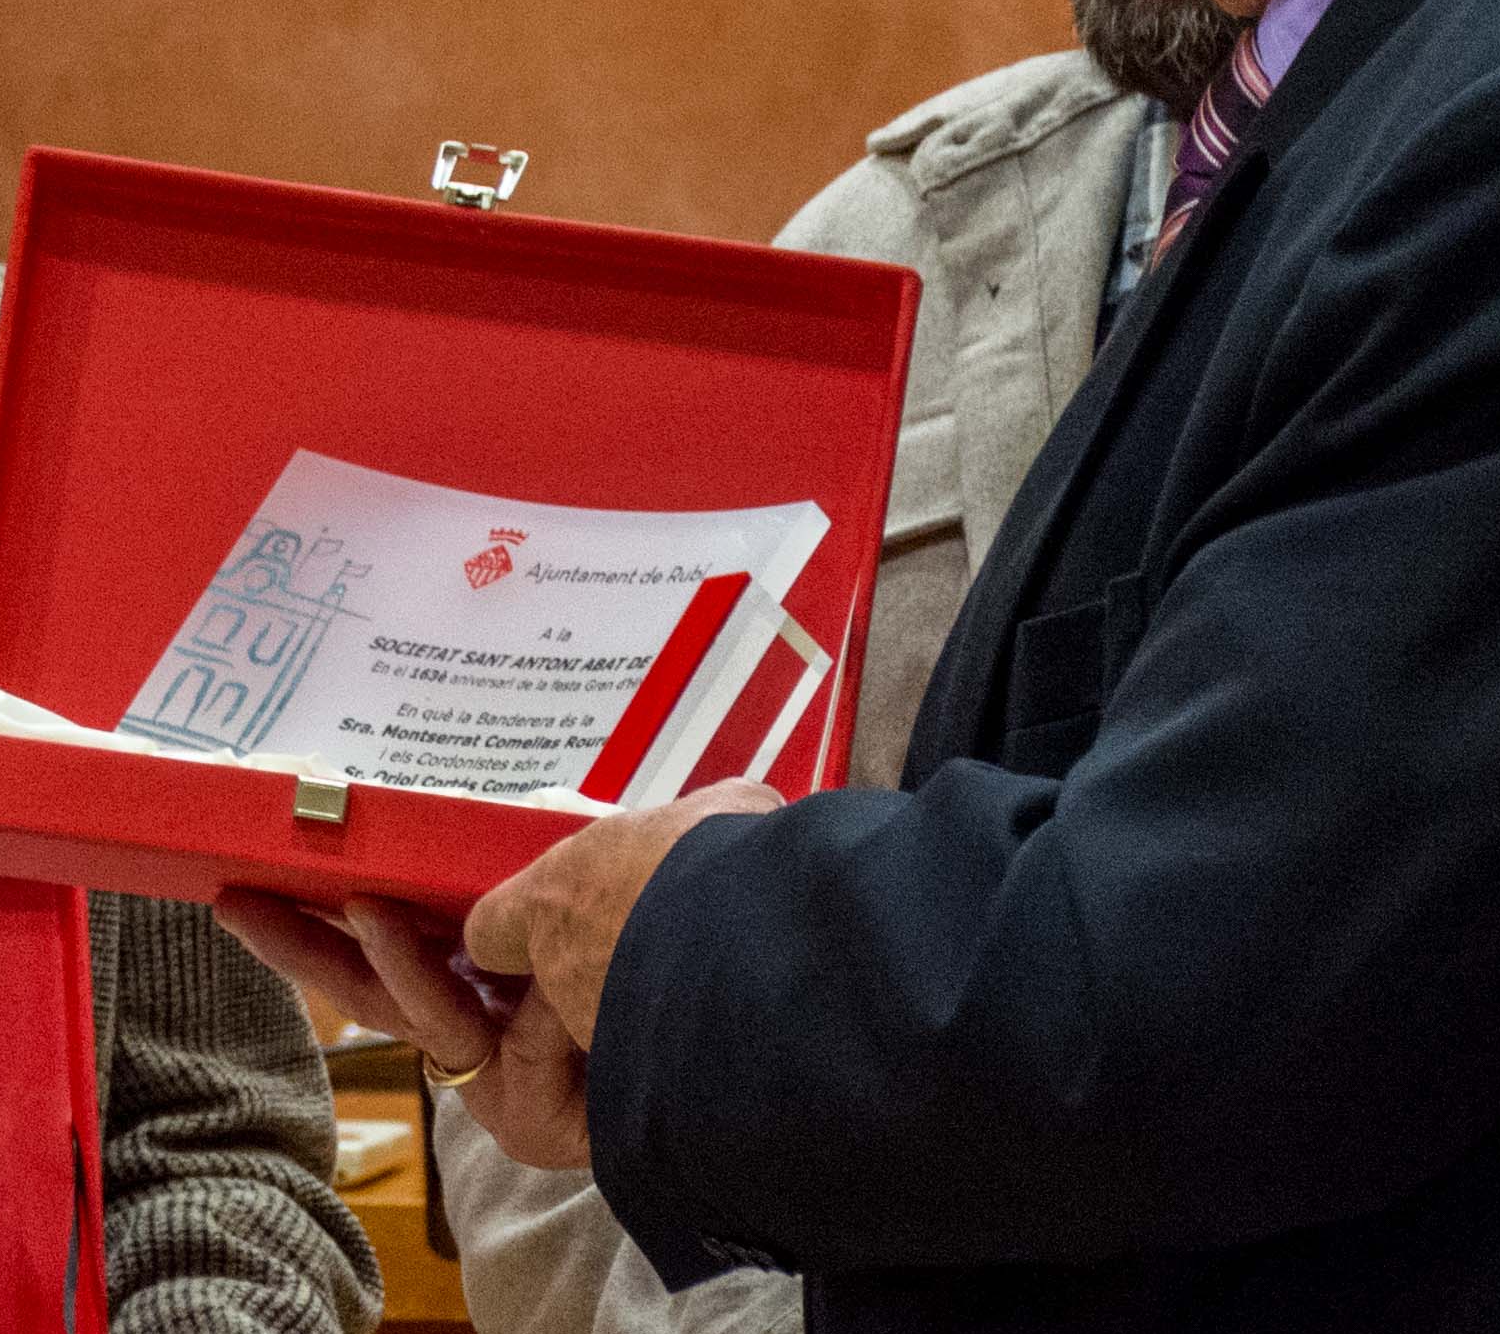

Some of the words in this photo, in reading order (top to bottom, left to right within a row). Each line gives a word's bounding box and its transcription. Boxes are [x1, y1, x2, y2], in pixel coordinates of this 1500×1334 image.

[525, 562, 638, 586] Ajuntament
[640, 566, 663, 585] de
[538, 627, 553, 641] A
[554, 627, 573, 643] la
[369, 635, 463, 664] SOCIETAT
[461, 650, 511, 668] SANT
[509, 654, 582, 671] ANTONI
[580, 657, 628, 671] ABAT
[626, 655, 654, 670] DE
[371, 660, 391, 675] En
[393, 664, 407, 677] el
[408, 667, 448, 685] 163è
[450, 672, 516, 690] aniversari
[517, 676, 534, 691] de
[535, 677, 548, 692] la
[550, 679, 582, 693] festa
[584, 678, 615, 692] Gran
[397, 703, 418, 718] En
[422, 705, 455, 724] què
[457, 710, 473, 726] la
[475, 712, 556, 729] Banderera
[559, 711, 578, 728] és
[579, 714, 595, 728] la
[338, 717, 376, 736] Sra.
[382, 723, 482, 748] Montserrat
[484, 734, 562, 751] Comellas
[389, 750, 414, 766] els
[416, 752, 510, 772] Cordonistes
[511, 756, 540, 772] són
[543, 758, 559, 772] el
